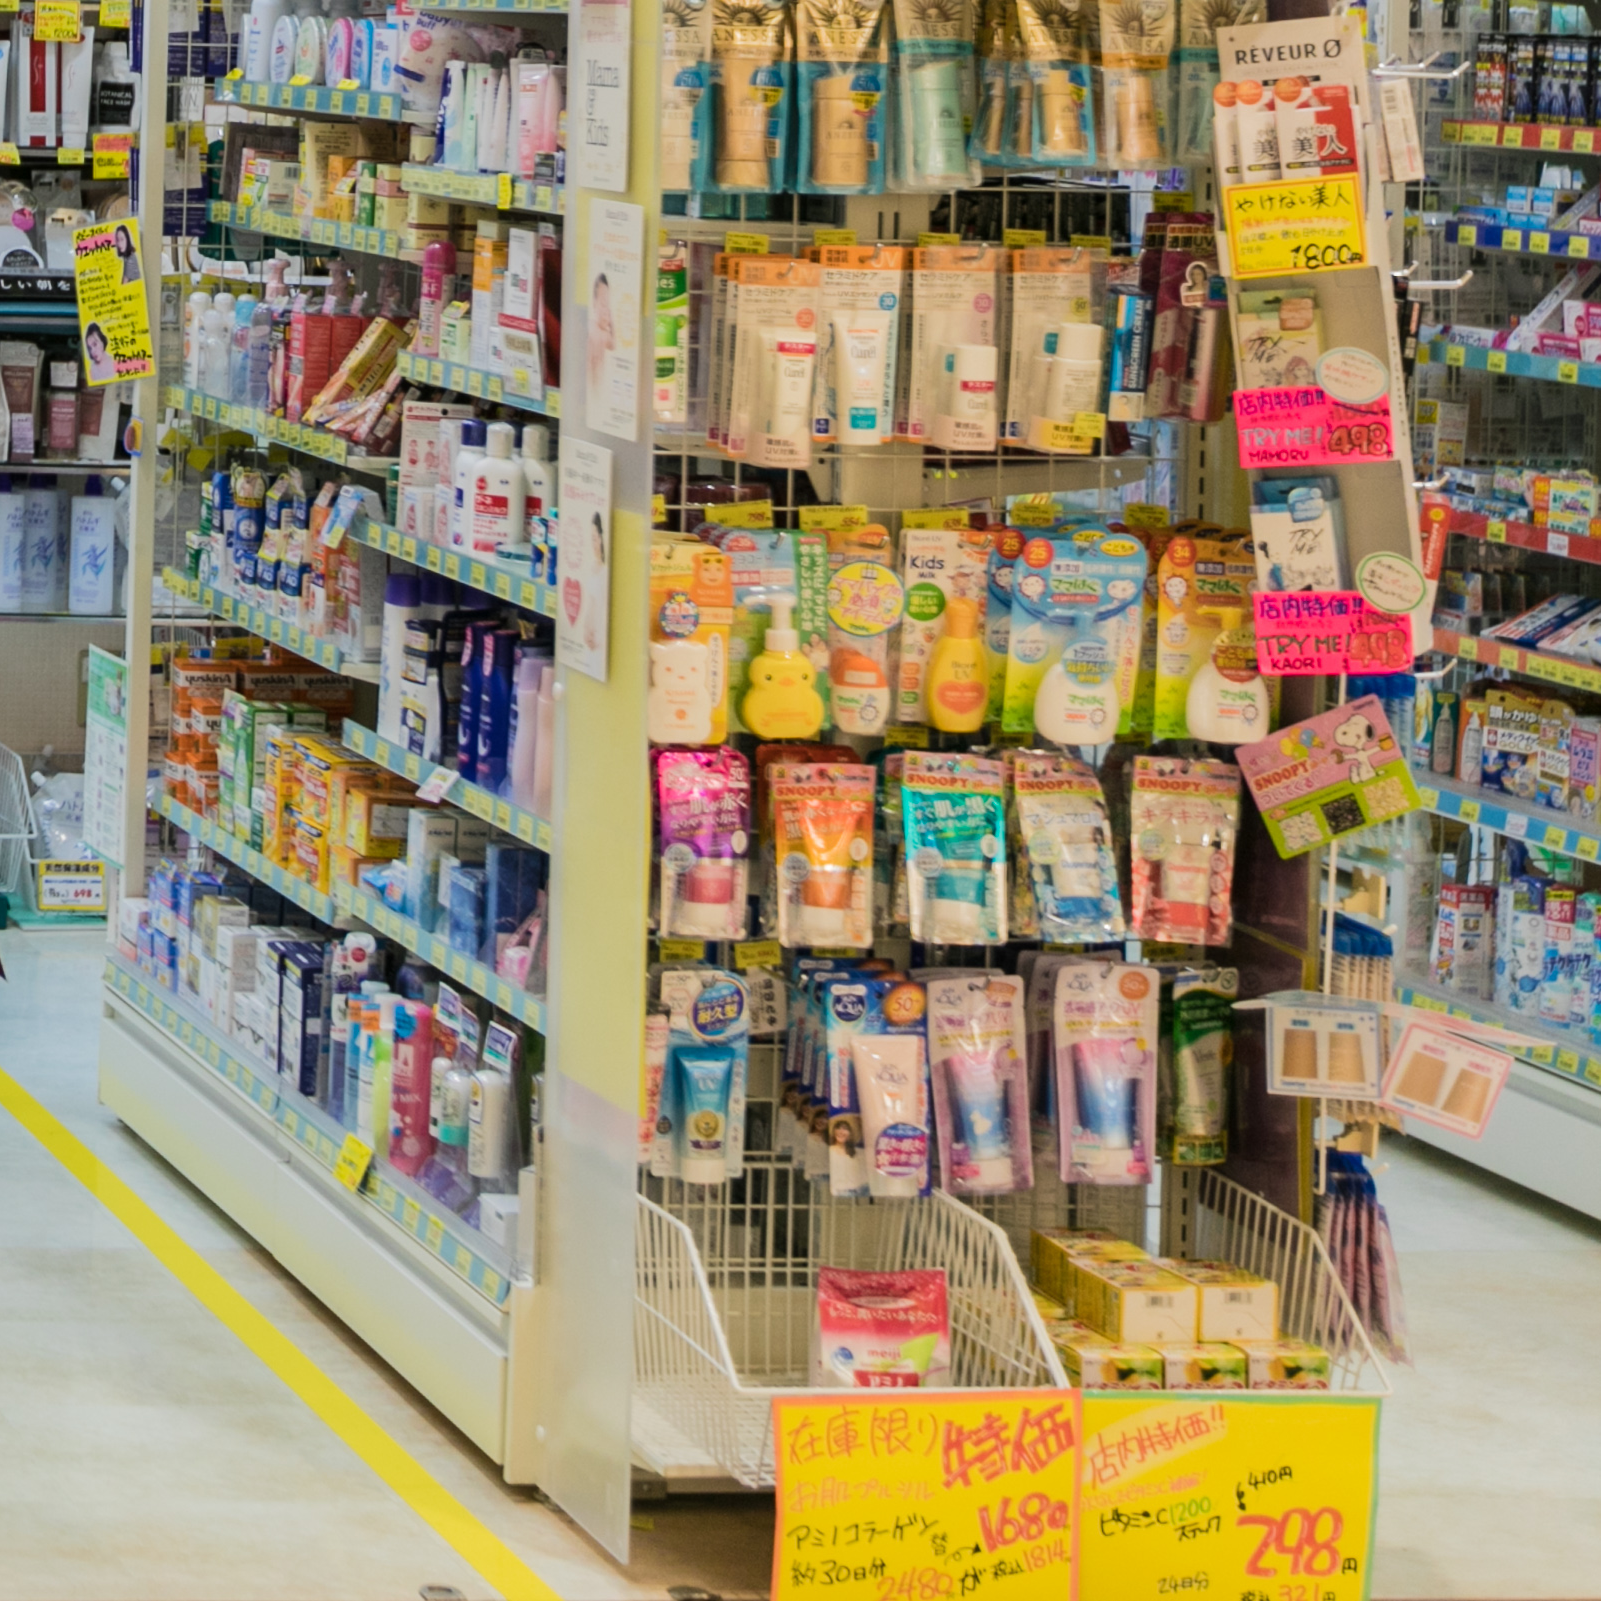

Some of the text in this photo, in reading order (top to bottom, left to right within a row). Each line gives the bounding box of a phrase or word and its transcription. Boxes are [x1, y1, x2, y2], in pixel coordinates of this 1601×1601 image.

[586, 59, 620, 88] Mama
[586, 118, 610, 146] Kids
[1294, 134, 1348, 159] 美人
[1234, 187, 1352, 212] やけない美人
[1242, 424, 1322, 447] TRY ME!
[1249, 448, 1309, 462] MAMORU
[1002, 536, 1021, 553] 25
[1029, 545, 1048, 561] 25
[1172, 544, 1192, 557] 34
[909, 553, 945, 574] Kids
[1262, 633, 1351, 656] TRY ME!
[1271, 657, 1322, 671] KAORI
[906, 776, 968, 792] SNOOPY
[1018, 776, 1078, 793] SNOOPY
[1136, 777, 1198, 793] SNOOPY
[1253, 760, 1310, 793] SNOOPY
[775, 783, 838, 798] SNOOPY
[867, 1346, 902, 1361] meiji
[787, 1406, 938, 1467] 在庫限り
[941, 1403, 1077, 1491] 特価
[1086, 1406, 1226, 1489] 店内特価!!
